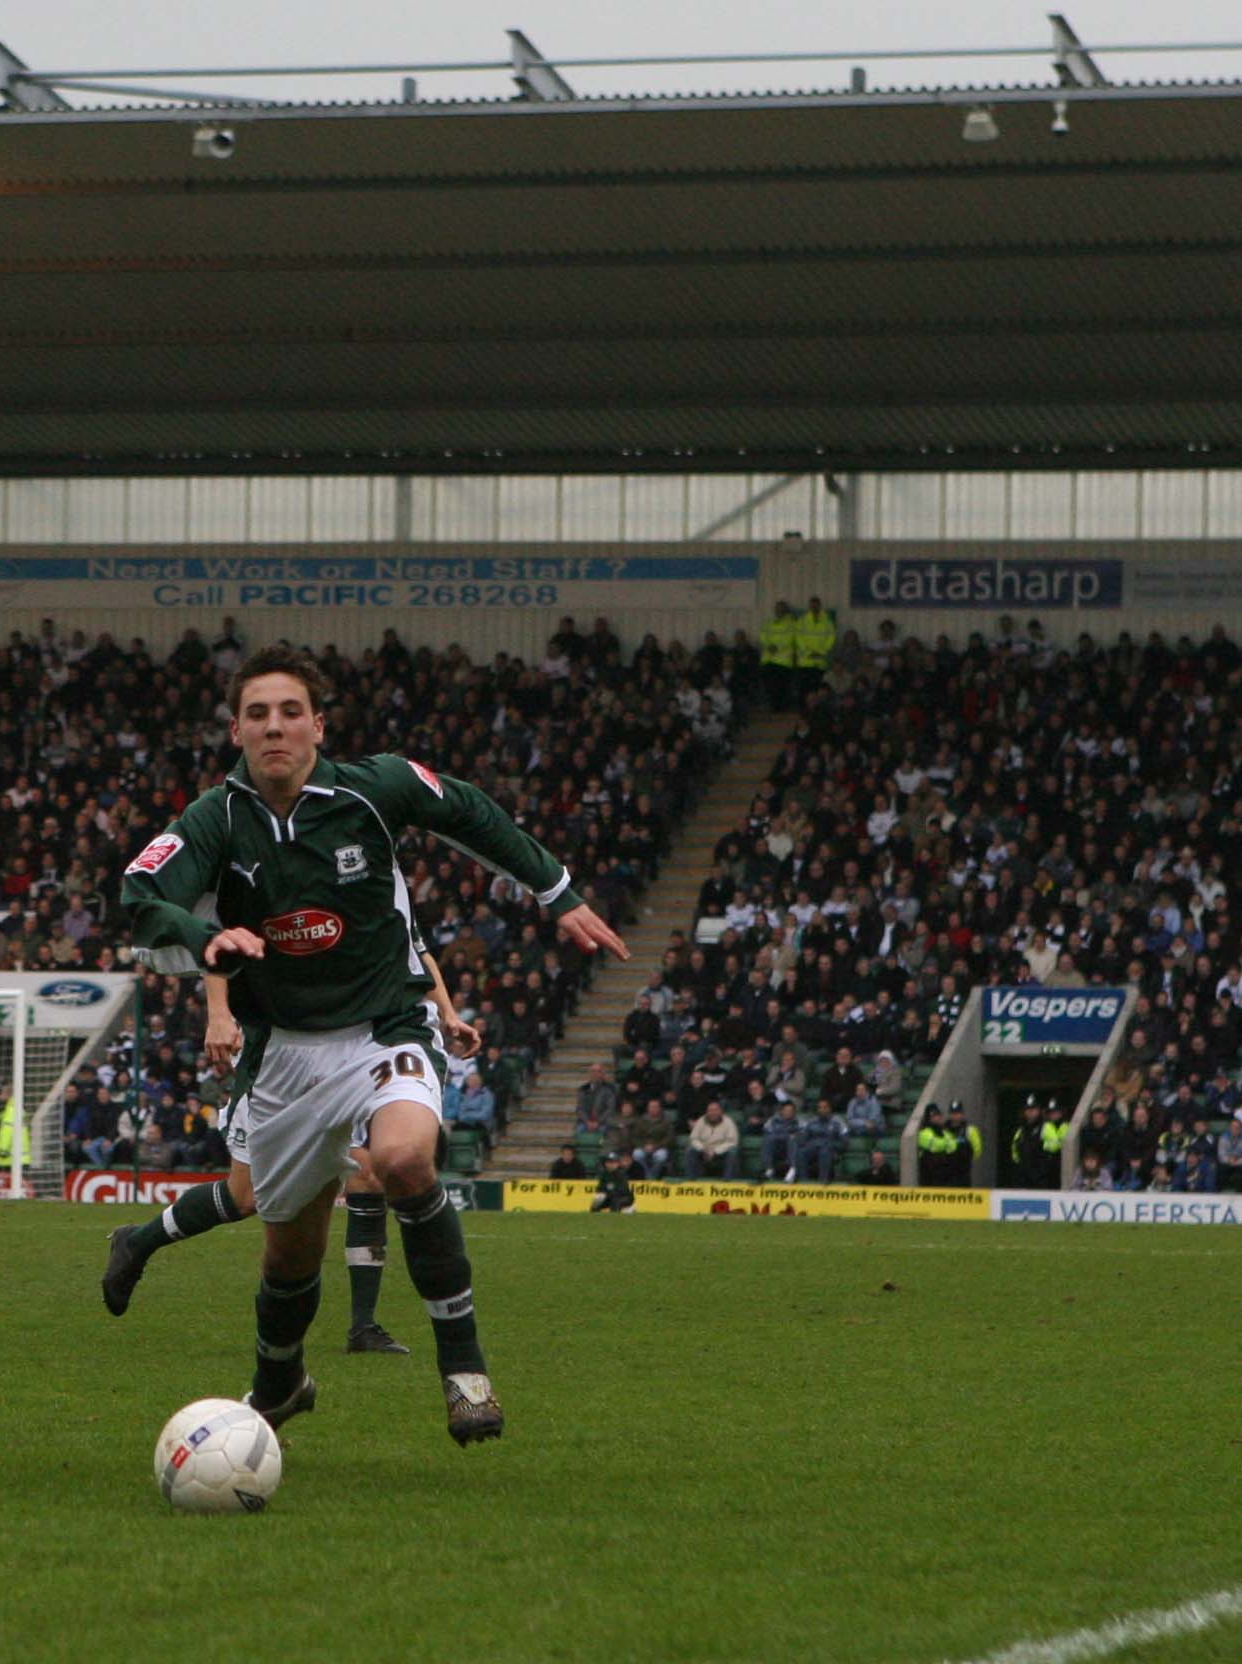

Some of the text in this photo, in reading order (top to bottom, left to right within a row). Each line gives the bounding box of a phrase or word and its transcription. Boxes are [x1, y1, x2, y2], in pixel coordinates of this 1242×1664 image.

[86, 559, 184, 578] Need
[202, 559, 301, 578] Work
[319, 564, 358, 578] or
[374, 559, 475, 578] Need
[493, 559, 591, 578] Staff
[152, 584, 224, 606] Call
[410, 585, 558, 606] 268268
[869, 560, 1101, 608] datasharp
[990, 990, 1117, 1022] Vospers
[984, 1021, 1023, 1043] 22
[369, 1051, 425, 1091] 30
[511, 1181, 535, 1193] For
[541, 1182, 560, 1193] all
[710, 1184, 754, 1198] home
[760, 1187, 867, 1201] improvement
[873, 1191, 983, 1205] requirements
